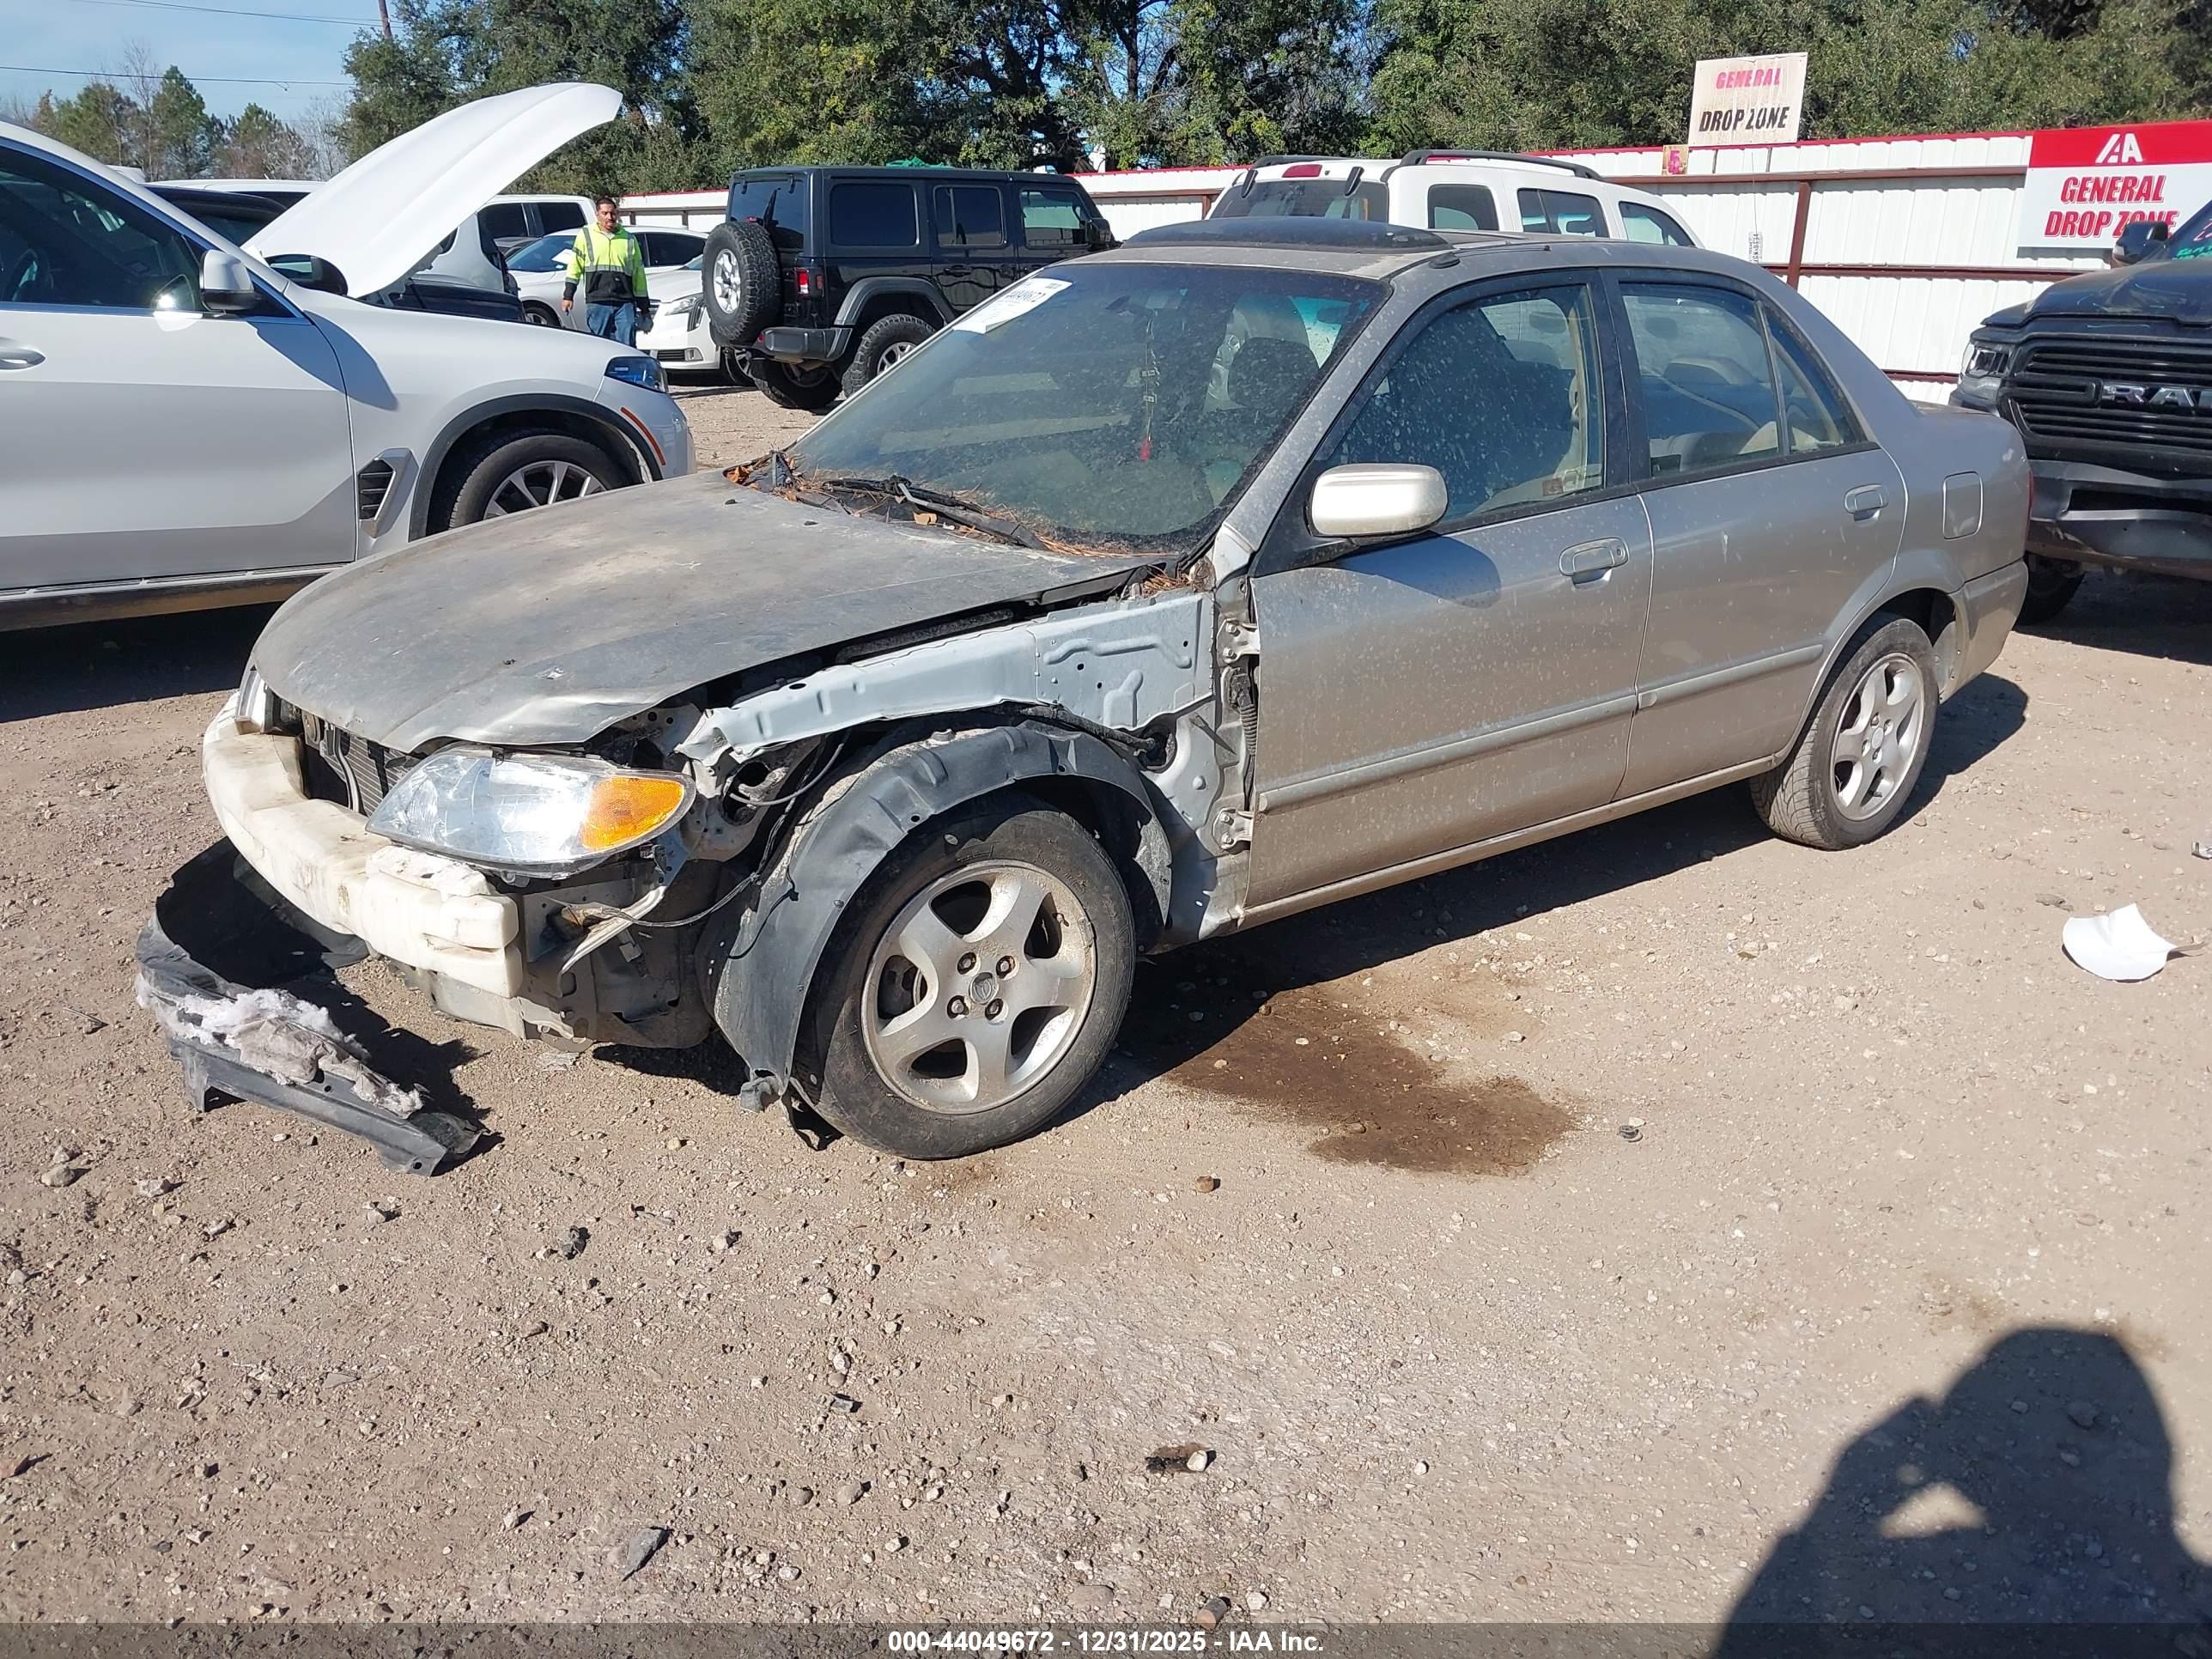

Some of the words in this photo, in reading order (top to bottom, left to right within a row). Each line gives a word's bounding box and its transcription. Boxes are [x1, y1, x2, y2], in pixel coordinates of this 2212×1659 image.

[1716, 68, 1781, 89] GENERAL
[1698, 109, 1745, 131] DROP
[1745, 106, 1790, 131] ZONE
[2060, 175, 2165, 203] GENERAL
[2045, 210, 2112, 237] DROP
